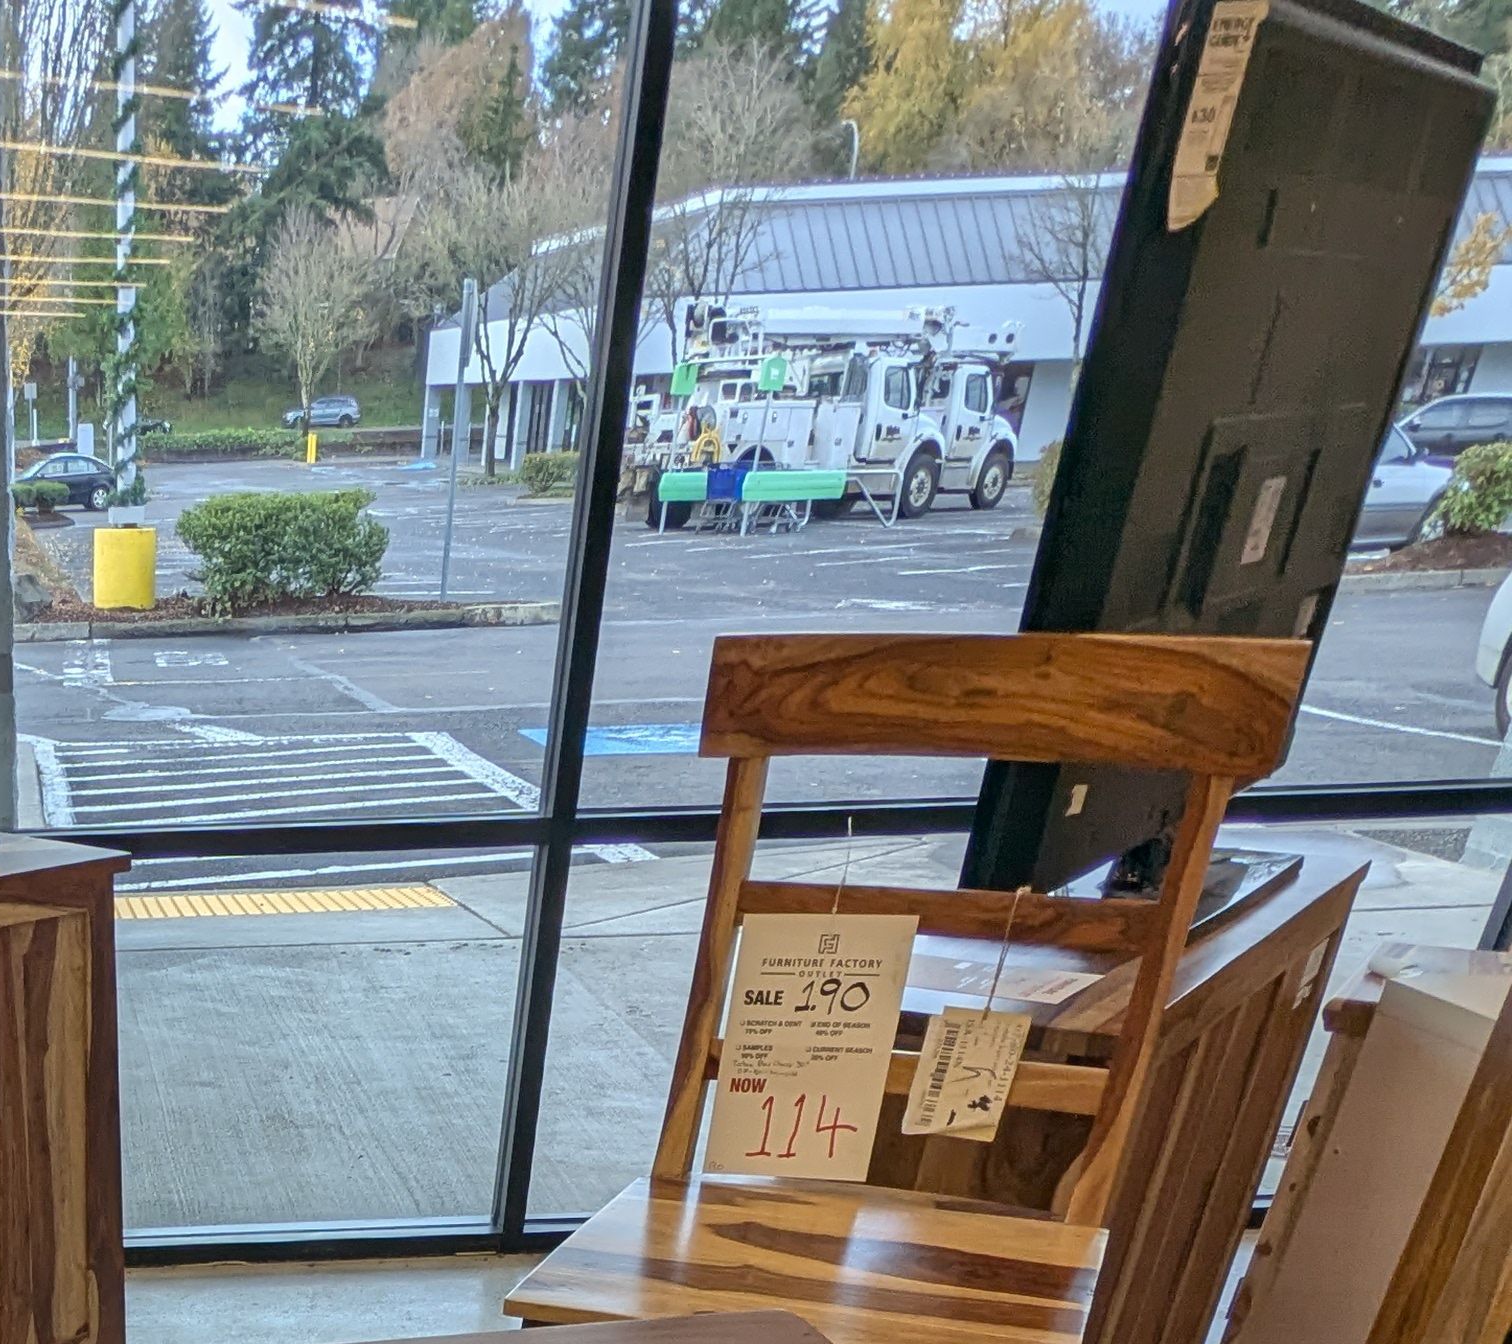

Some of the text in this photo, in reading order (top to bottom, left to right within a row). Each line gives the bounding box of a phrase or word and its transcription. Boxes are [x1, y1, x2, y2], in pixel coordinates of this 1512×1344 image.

[761, 958, 883, 968] FURNITURE FACTORY
[798, 970, 842, 978] OUTLET
[743, 989, 784, 1006] SALE
[784, 1020, 803, 1028] DENT
[729, 1077, 768, 1093] NOW
[745, 1093, 858, 1158] 114
